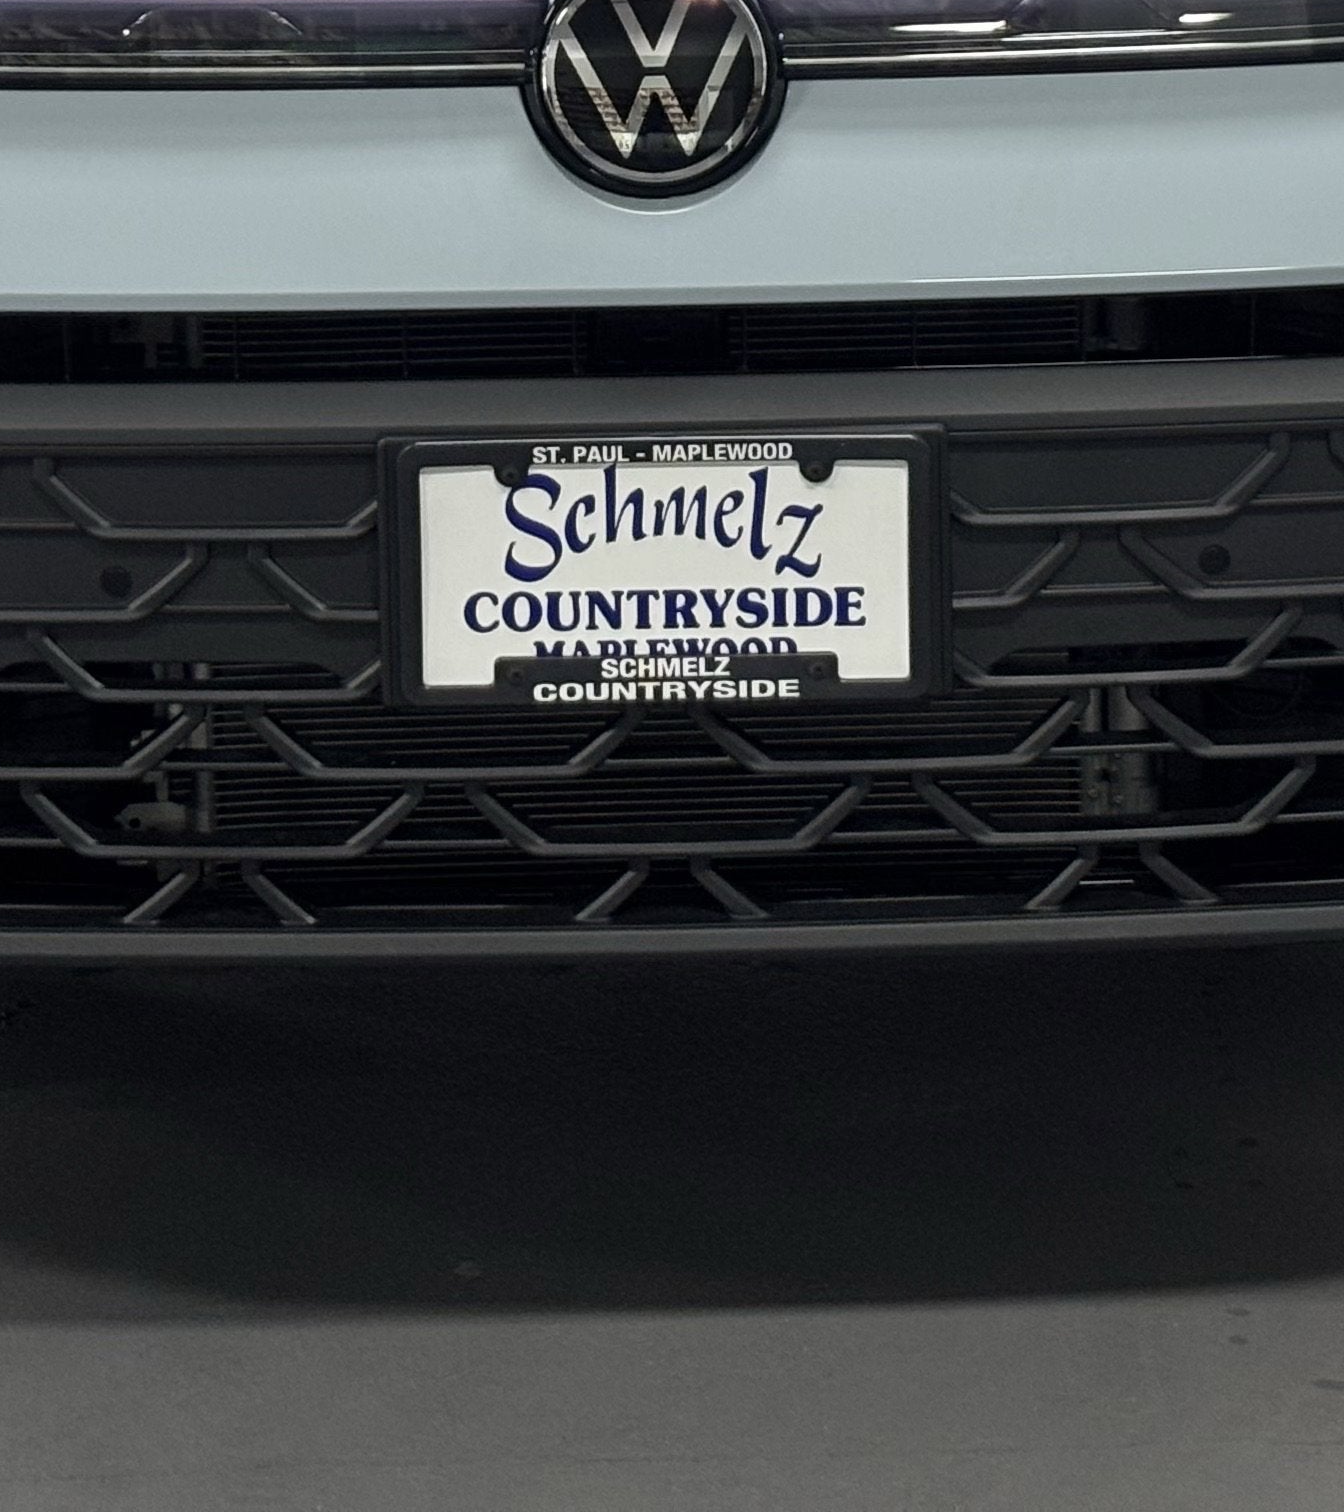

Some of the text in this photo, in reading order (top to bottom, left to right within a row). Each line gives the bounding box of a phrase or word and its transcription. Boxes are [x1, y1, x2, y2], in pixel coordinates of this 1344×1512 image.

[532, 445, 567, 465] ST.
[573, 445, 630, 464] PAUL
[652, 442, 793, 462] MAPLEWOOD
[504, 464, 823, 582] Schmelz
[463, 586, 866, 633] COUNTRYSIDE
[601, 656, 730, 678] SCHMELZ
[533, 679, 801, 702] COUNTRYSIDE
